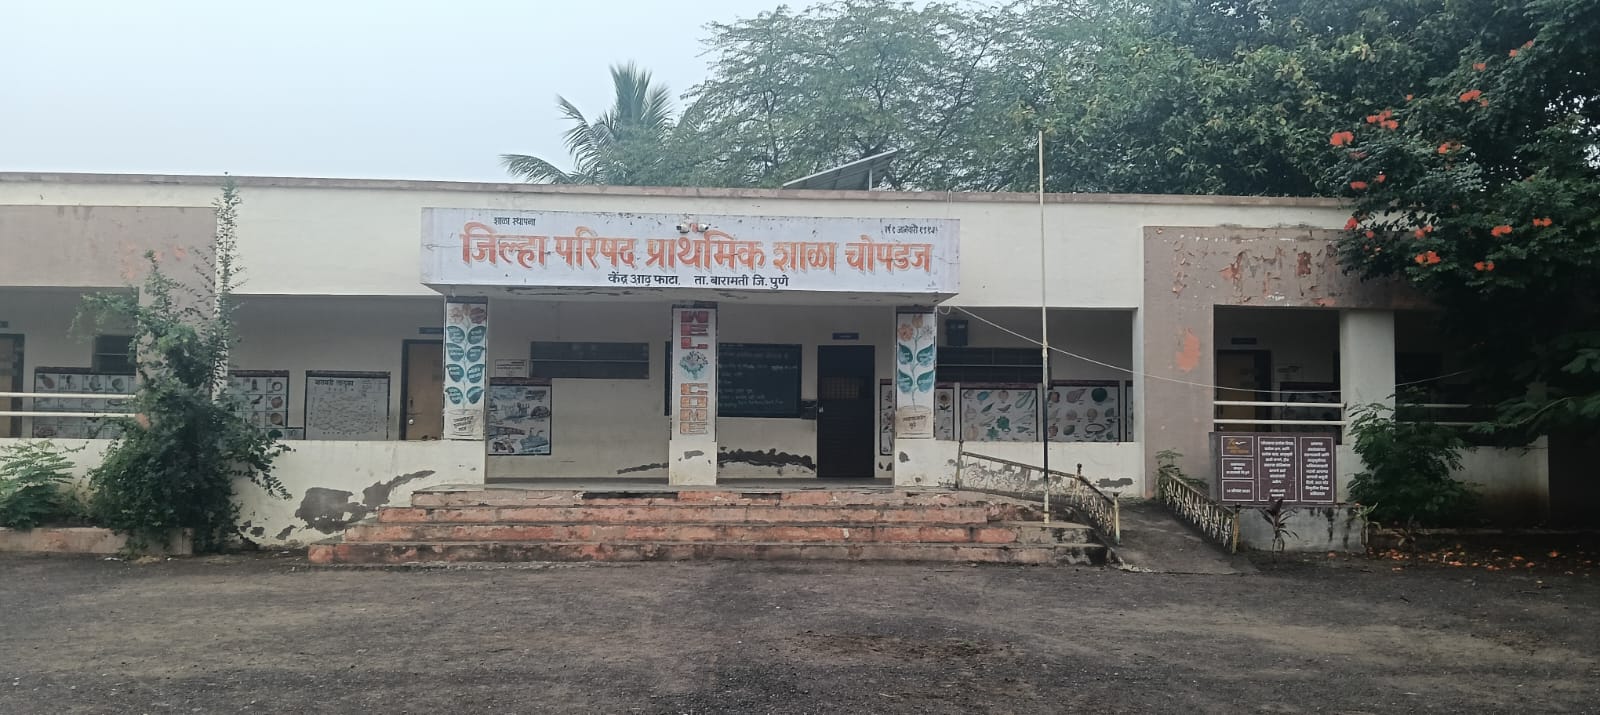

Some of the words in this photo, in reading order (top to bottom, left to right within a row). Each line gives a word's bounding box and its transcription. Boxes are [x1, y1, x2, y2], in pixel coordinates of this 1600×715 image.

[494, 217, 510, 226] शाळा
[512, 217, 536, 226] स्थापना
[459, 222, 550, 269] जिल्हा
[553, 226, 639, 270] परिषद
[645, 229, 767, 271] प्राथमिक
[772, 241, 838, 273] शाळा
[845, 234, 934, 273] चोपडज
[608, 271, 628, 284] केंद्र
[694, 275, 709, 285] ता.
[710, 274, 749, 286] बारामती
[752, 273, 768, 286] जि.
[769, 275, 789, 289] पुणे
